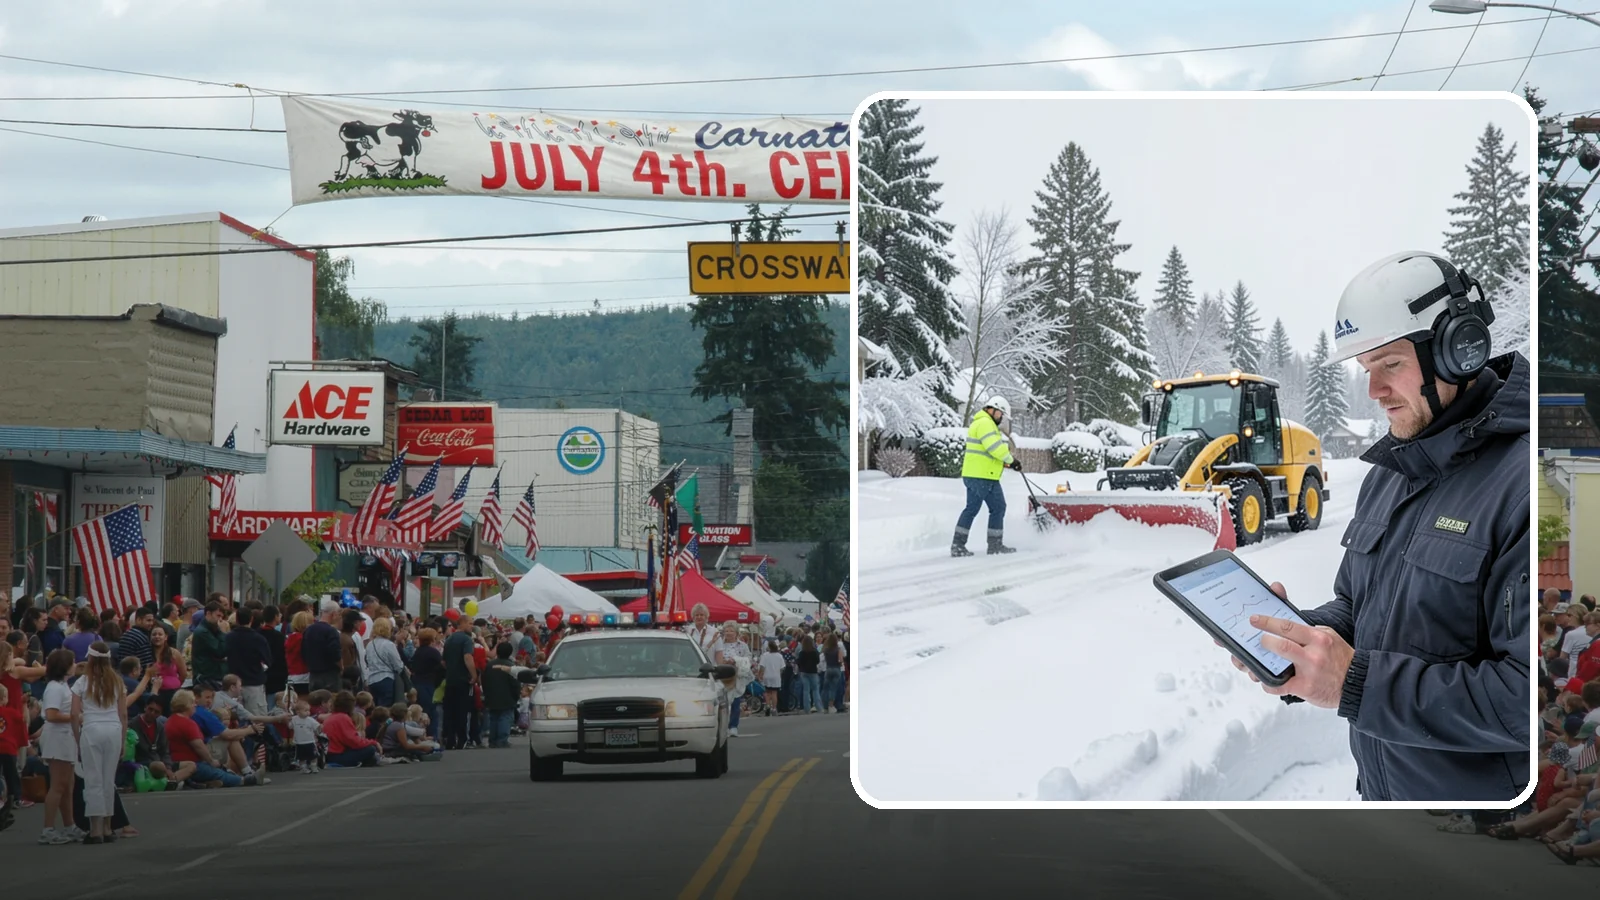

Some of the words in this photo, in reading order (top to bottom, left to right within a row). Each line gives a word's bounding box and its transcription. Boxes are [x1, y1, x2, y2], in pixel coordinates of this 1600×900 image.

[695, 121, 850, 149] Carnat
[481, 141, 604, 192] JULY
[632, 150, 746, 197] 4th.
[697, 254, 850, 279] CROSSWA
[283, 380, 373, 420] ACE
[405, 409, 453, 422] CEDAR
[461, 409, 485, 422] LOG
[283, 421, 370, 436] Hardware
[416, 428, 477, 447] Coca-Cola
[353, 467, 383, 480] Simpl
[96, 485, 124, 494] Vincent
[126, 486, 136, 494] de
[137, 486, 155, 495] Paul
[688, 526, 741, 535] CRNATION
[699, 535, 730, 543] GLASS
